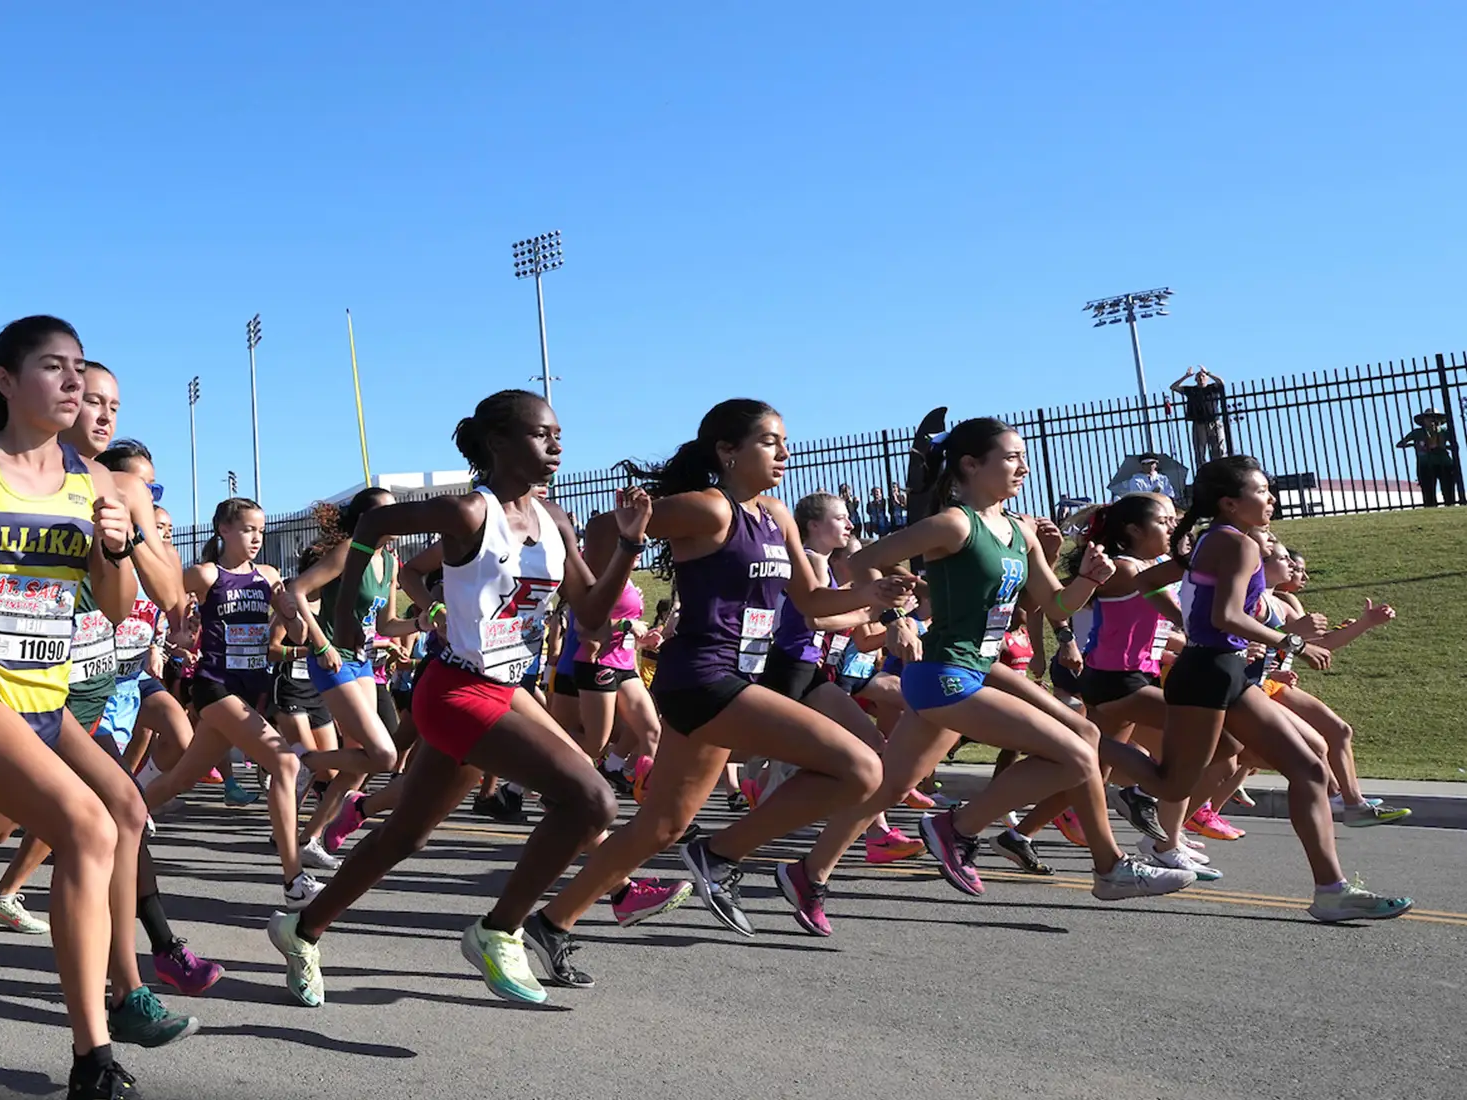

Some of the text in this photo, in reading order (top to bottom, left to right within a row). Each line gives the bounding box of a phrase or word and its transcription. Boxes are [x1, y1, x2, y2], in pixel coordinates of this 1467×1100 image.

[24, 580, 62, 600] SAC
[226, 589, 265, 601] RANCHO
[216, 600, 270, 617] CUCAMONG
[81, 613, 105, 631] SAC
[115, 625, 141, 636] SAC
[19, 639, 64, 661] 11090
[82, 655, 114, 679] 12858
[508, 658, 533, 682] 82
